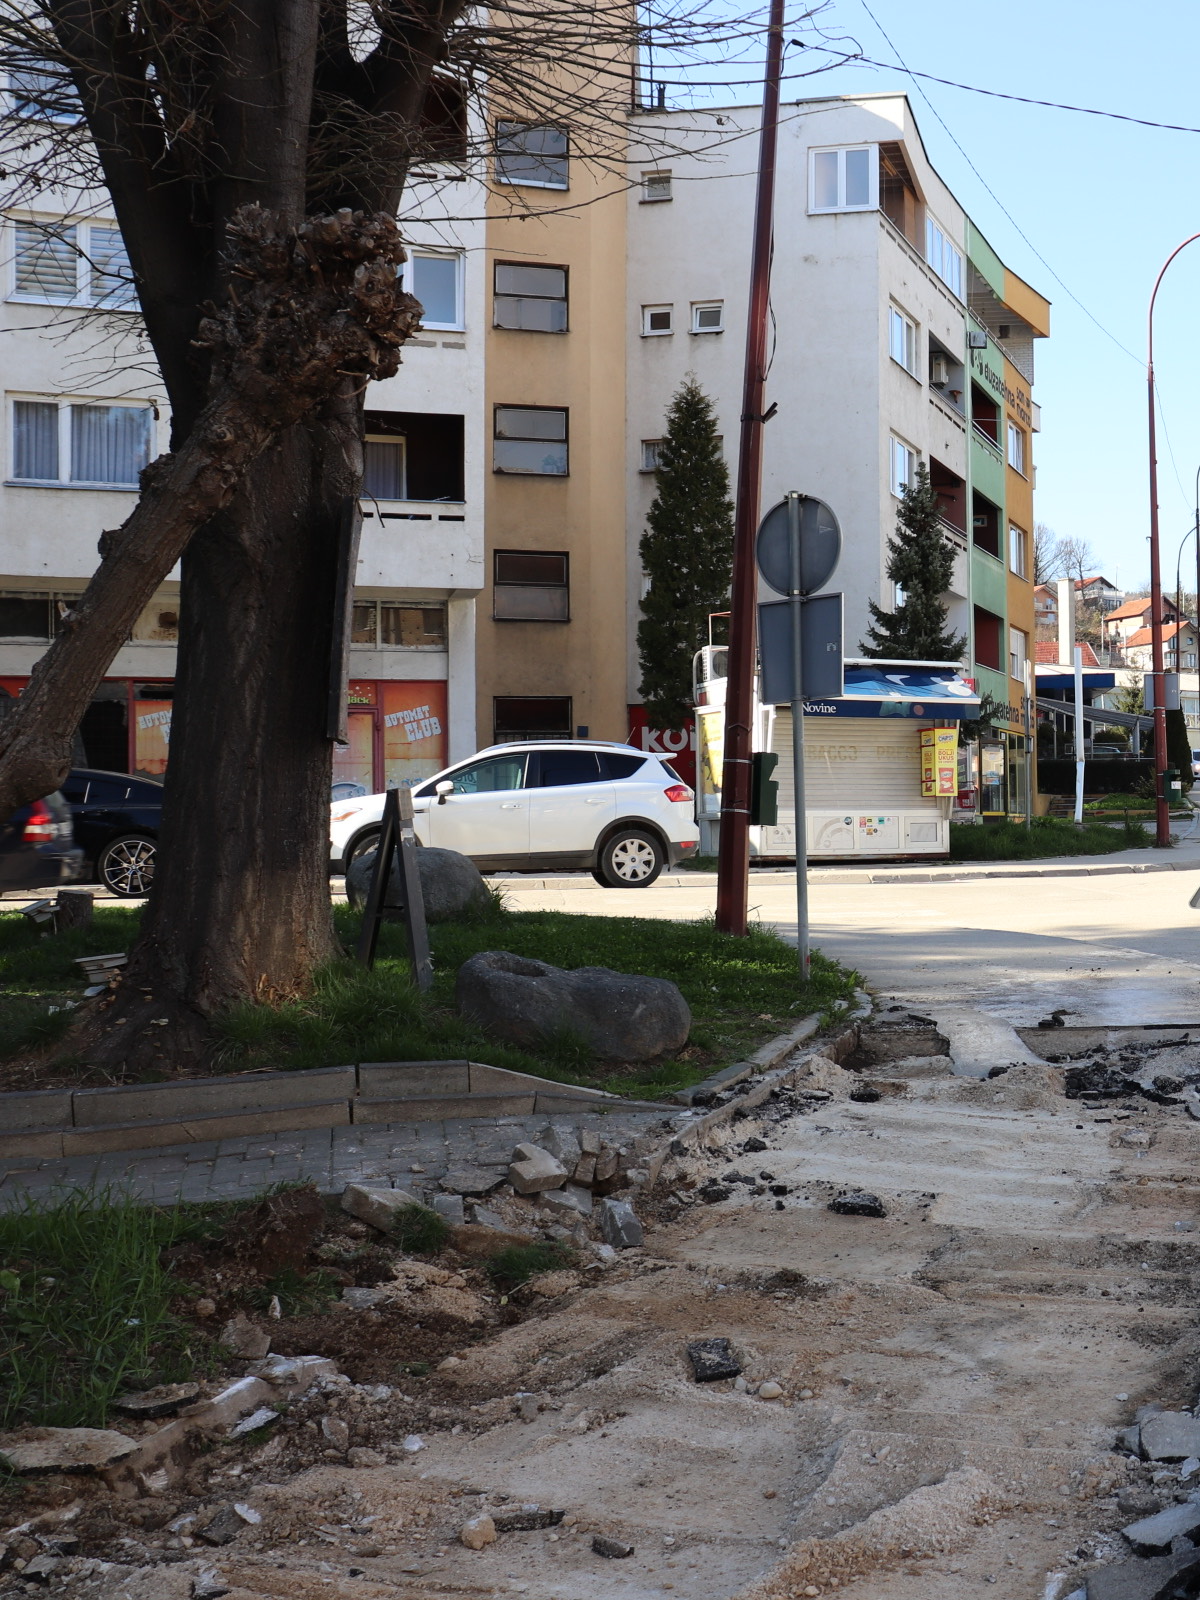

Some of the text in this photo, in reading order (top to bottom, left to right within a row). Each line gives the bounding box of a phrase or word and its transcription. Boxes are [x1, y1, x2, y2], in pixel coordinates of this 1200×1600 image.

[384, 705, 430, 727] AUTOMAT
[803, 701, 837, 714] Novine
[404, 716, 441, 742] CLUB
